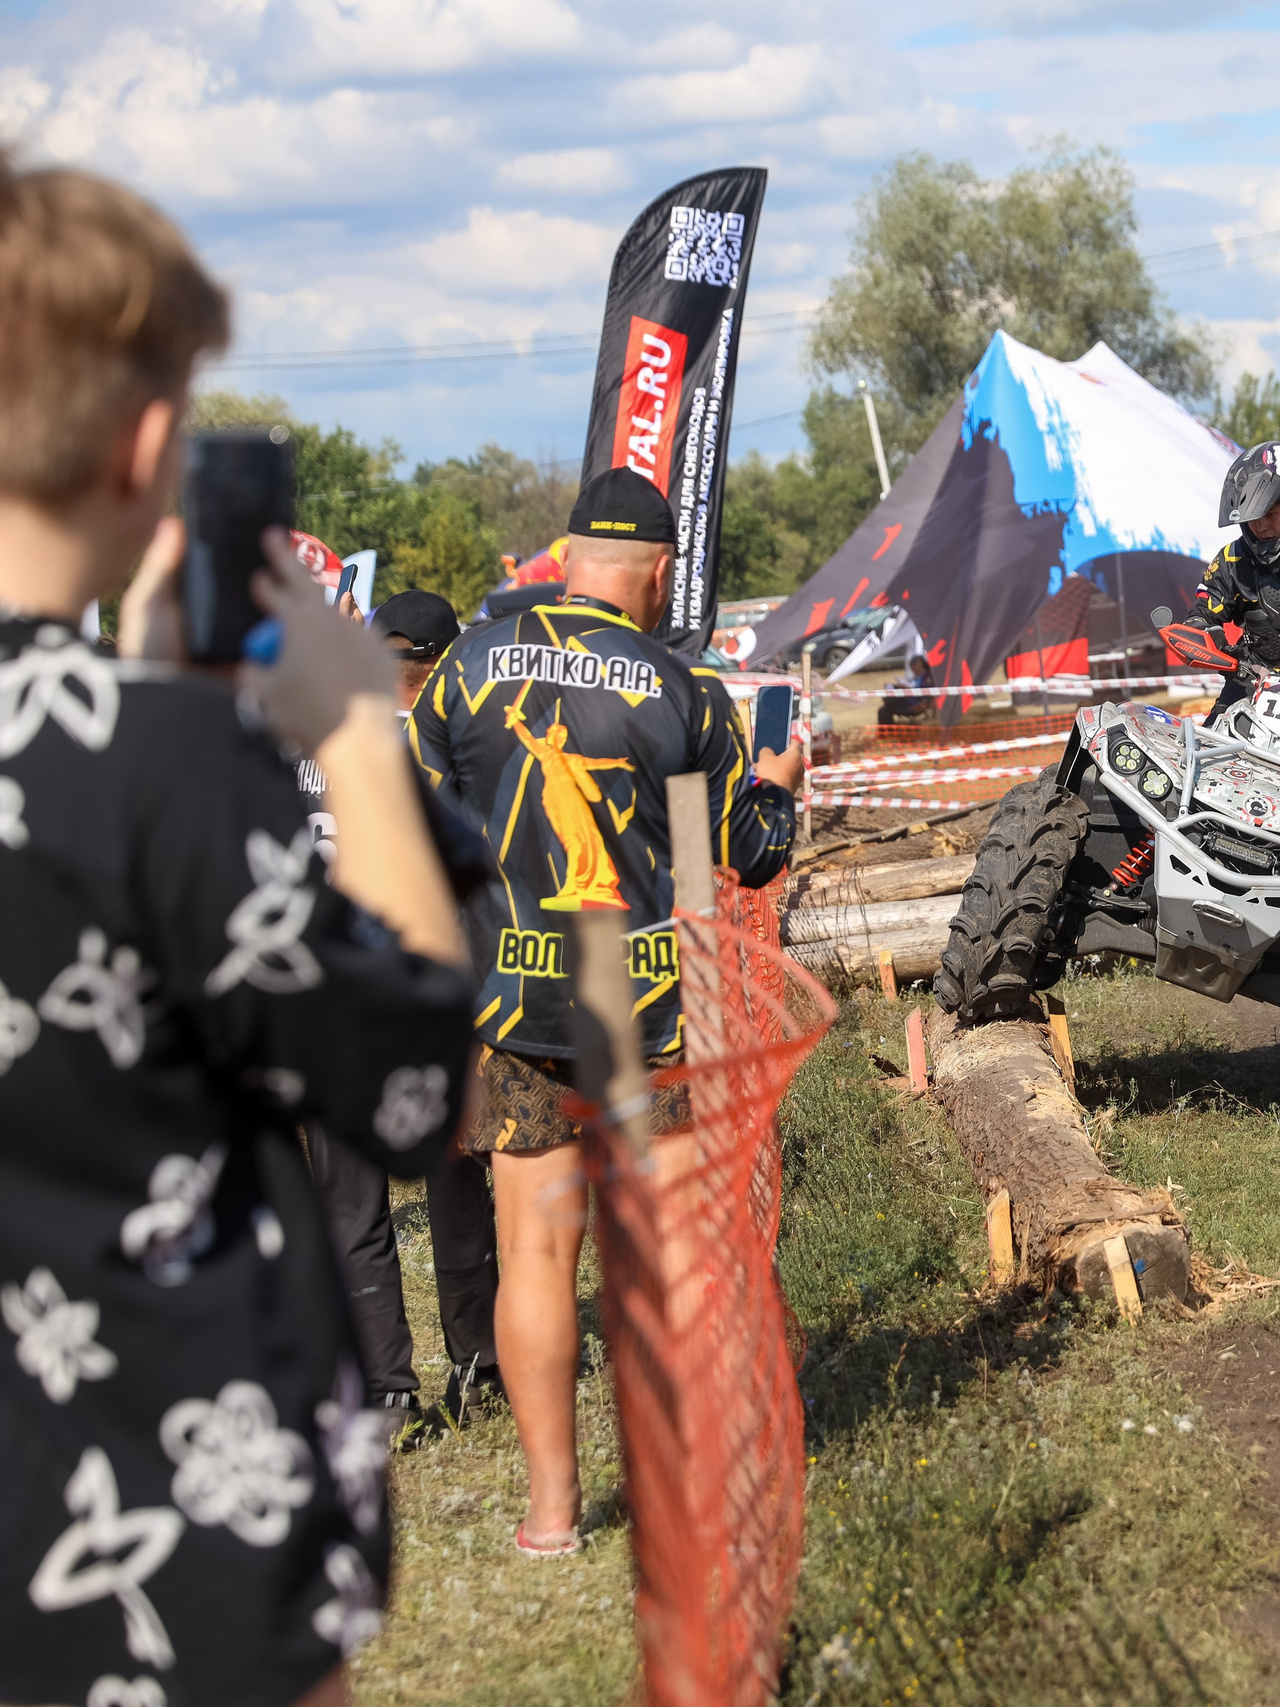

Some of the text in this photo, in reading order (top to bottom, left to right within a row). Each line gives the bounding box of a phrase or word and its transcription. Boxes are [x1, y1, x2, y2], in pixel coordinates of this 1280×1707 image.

[626, 332, 672, 480] TAL.RU
[707, 399, 720, 412] И
[698, 412, 719, 503] АКСЕССУАРЫ
[671, 387, 707, 629] ЗАПАСНЫЕ ЧАСТИ ДЛЯ СНЕГОХОДОВ
[688, 617, 702, 631] И
[488, 644, 662, 698] КВИТКО А.А.
[498, 928, 680, 982] ВОЛАД
